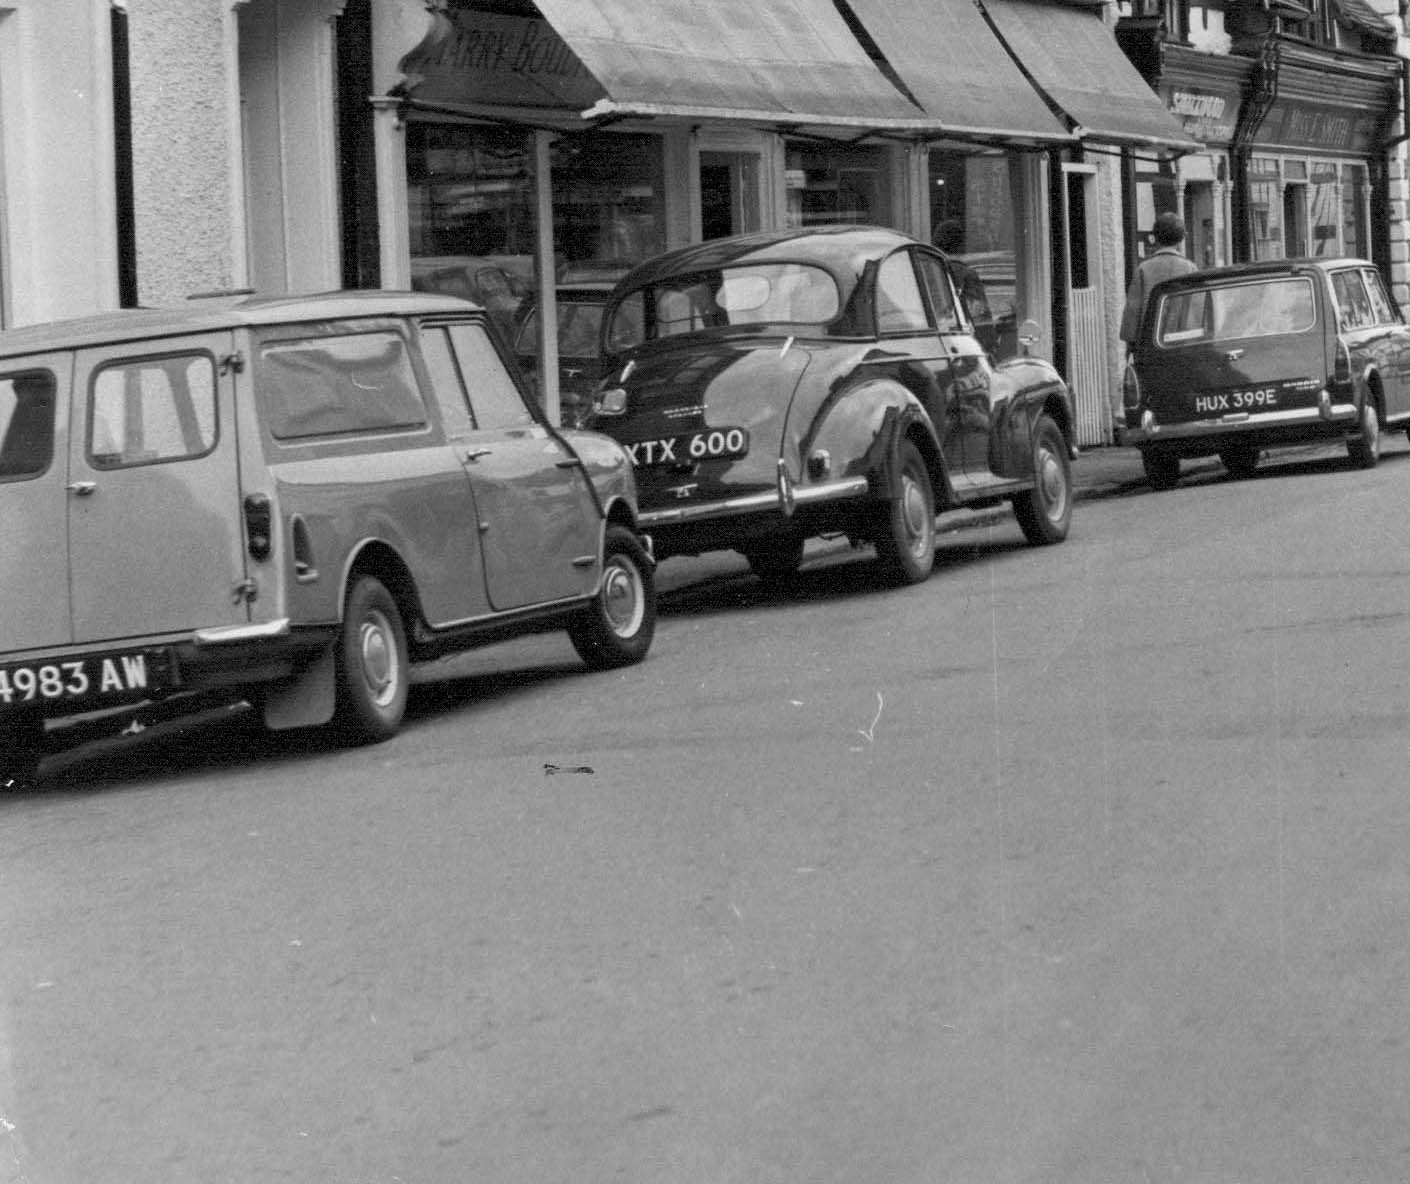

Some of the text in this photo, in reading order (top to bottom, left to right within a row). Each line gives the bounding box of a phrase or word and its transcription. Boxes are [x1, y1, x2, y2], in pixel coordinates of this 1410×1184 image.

[1196, 388, 1277, 412] HUX 399E
[624, 428, 744, 466] XTX 600
[0, 654, 147, 703] 4983 AW
